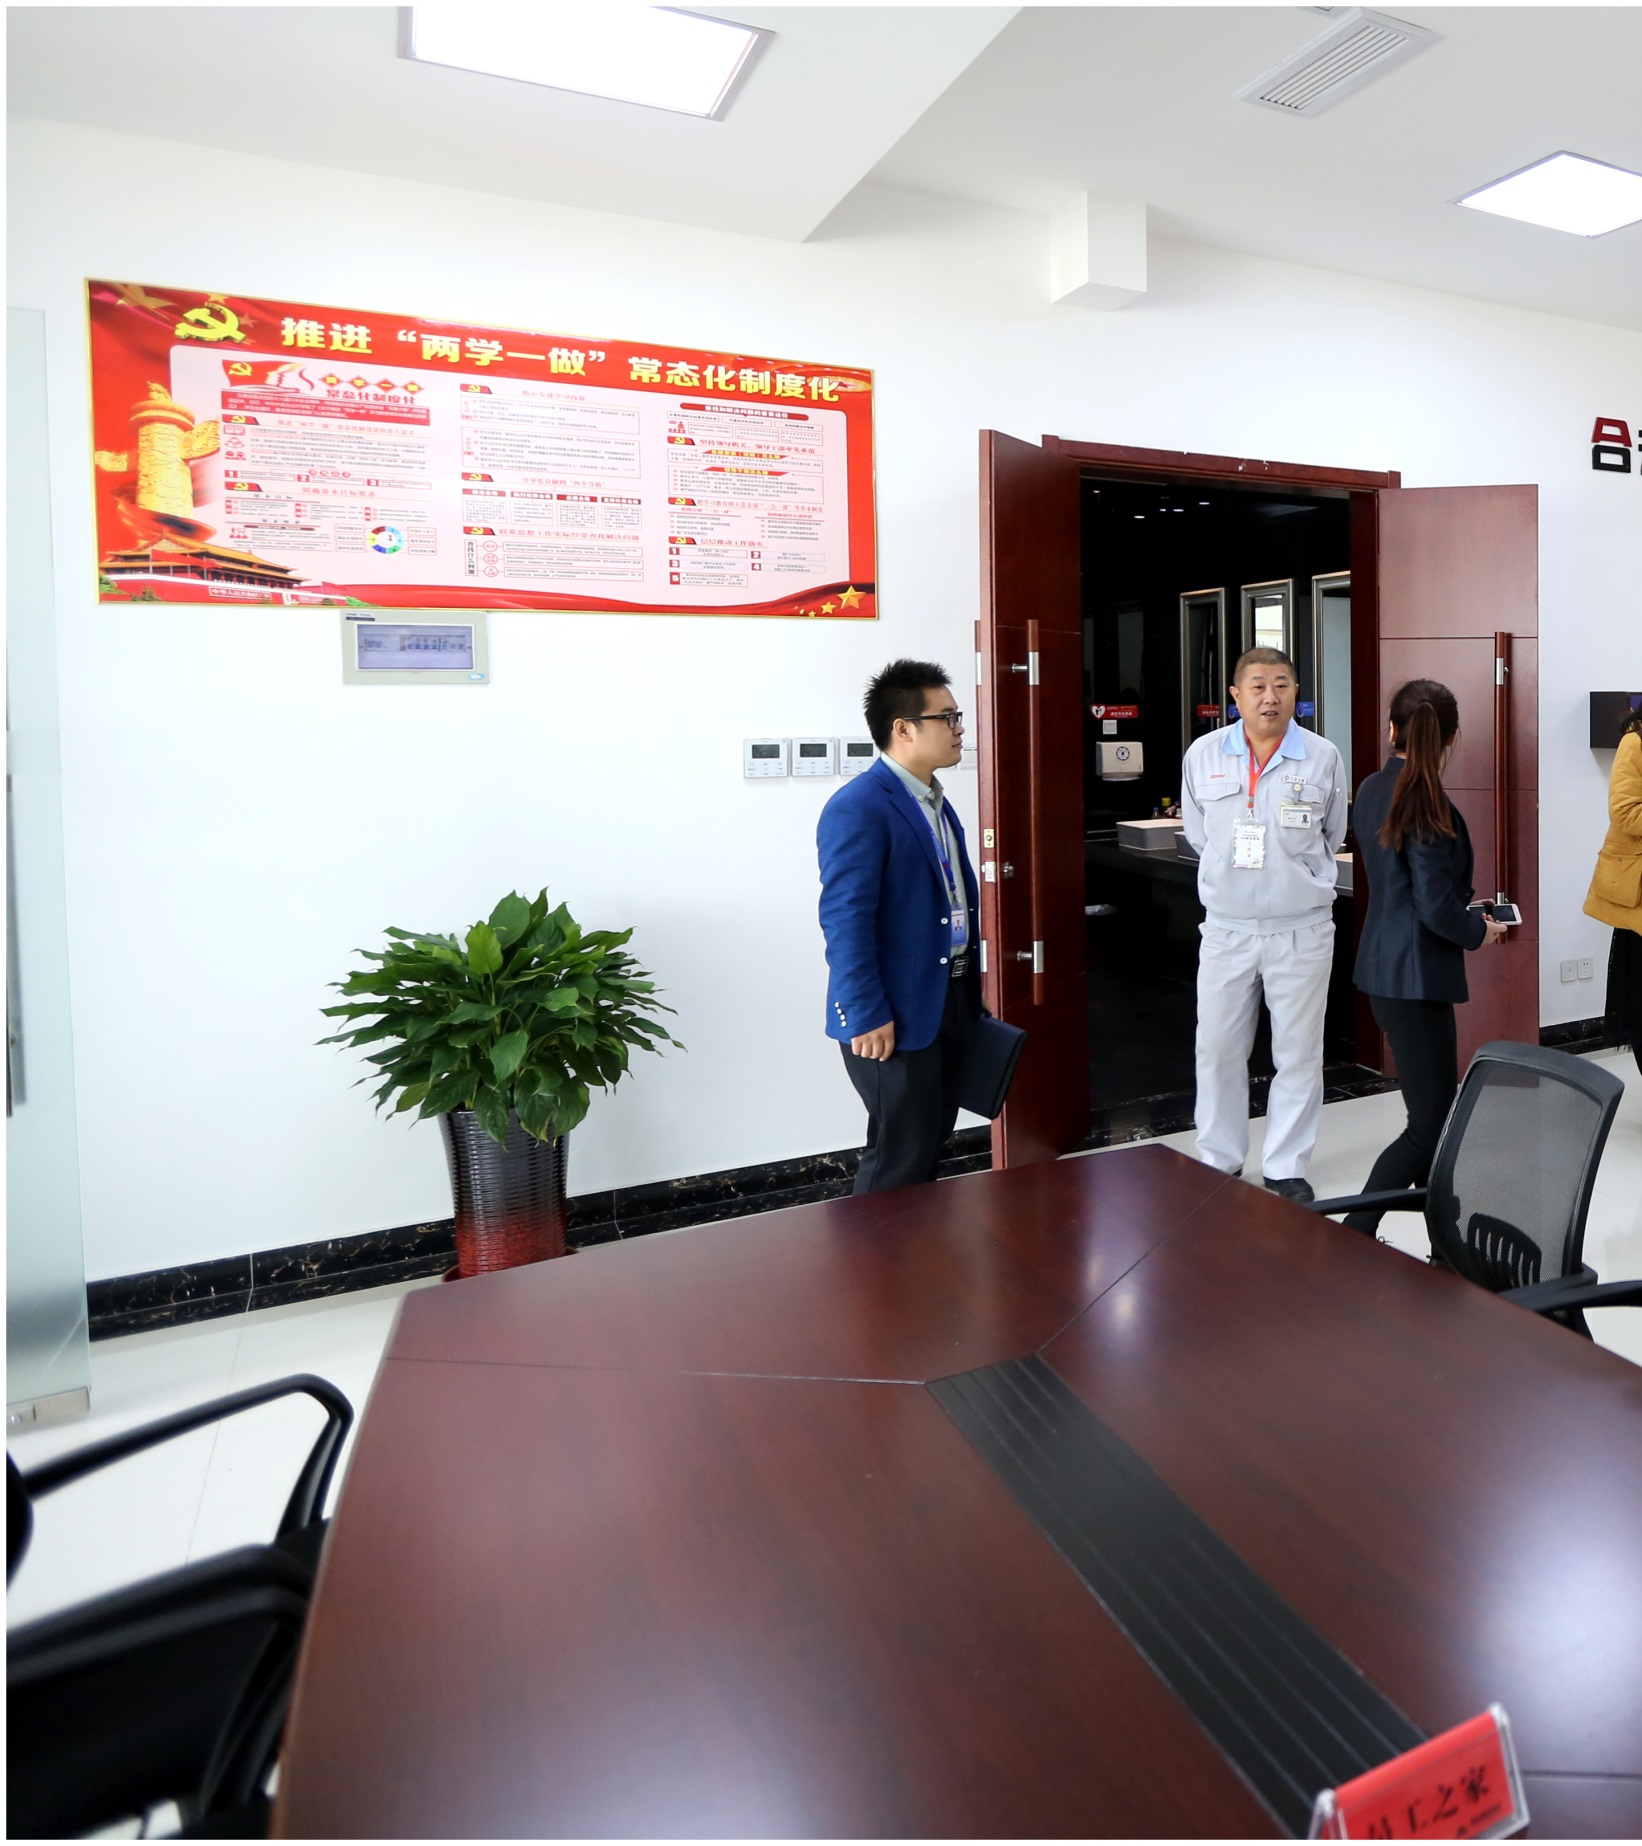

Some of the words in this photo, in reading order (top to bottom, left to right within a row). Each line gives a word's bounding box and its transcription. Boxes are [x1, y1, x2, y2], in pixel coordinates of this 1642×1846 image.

[281, 317, 840, 402] 推进“两学一做”常态化制度化
